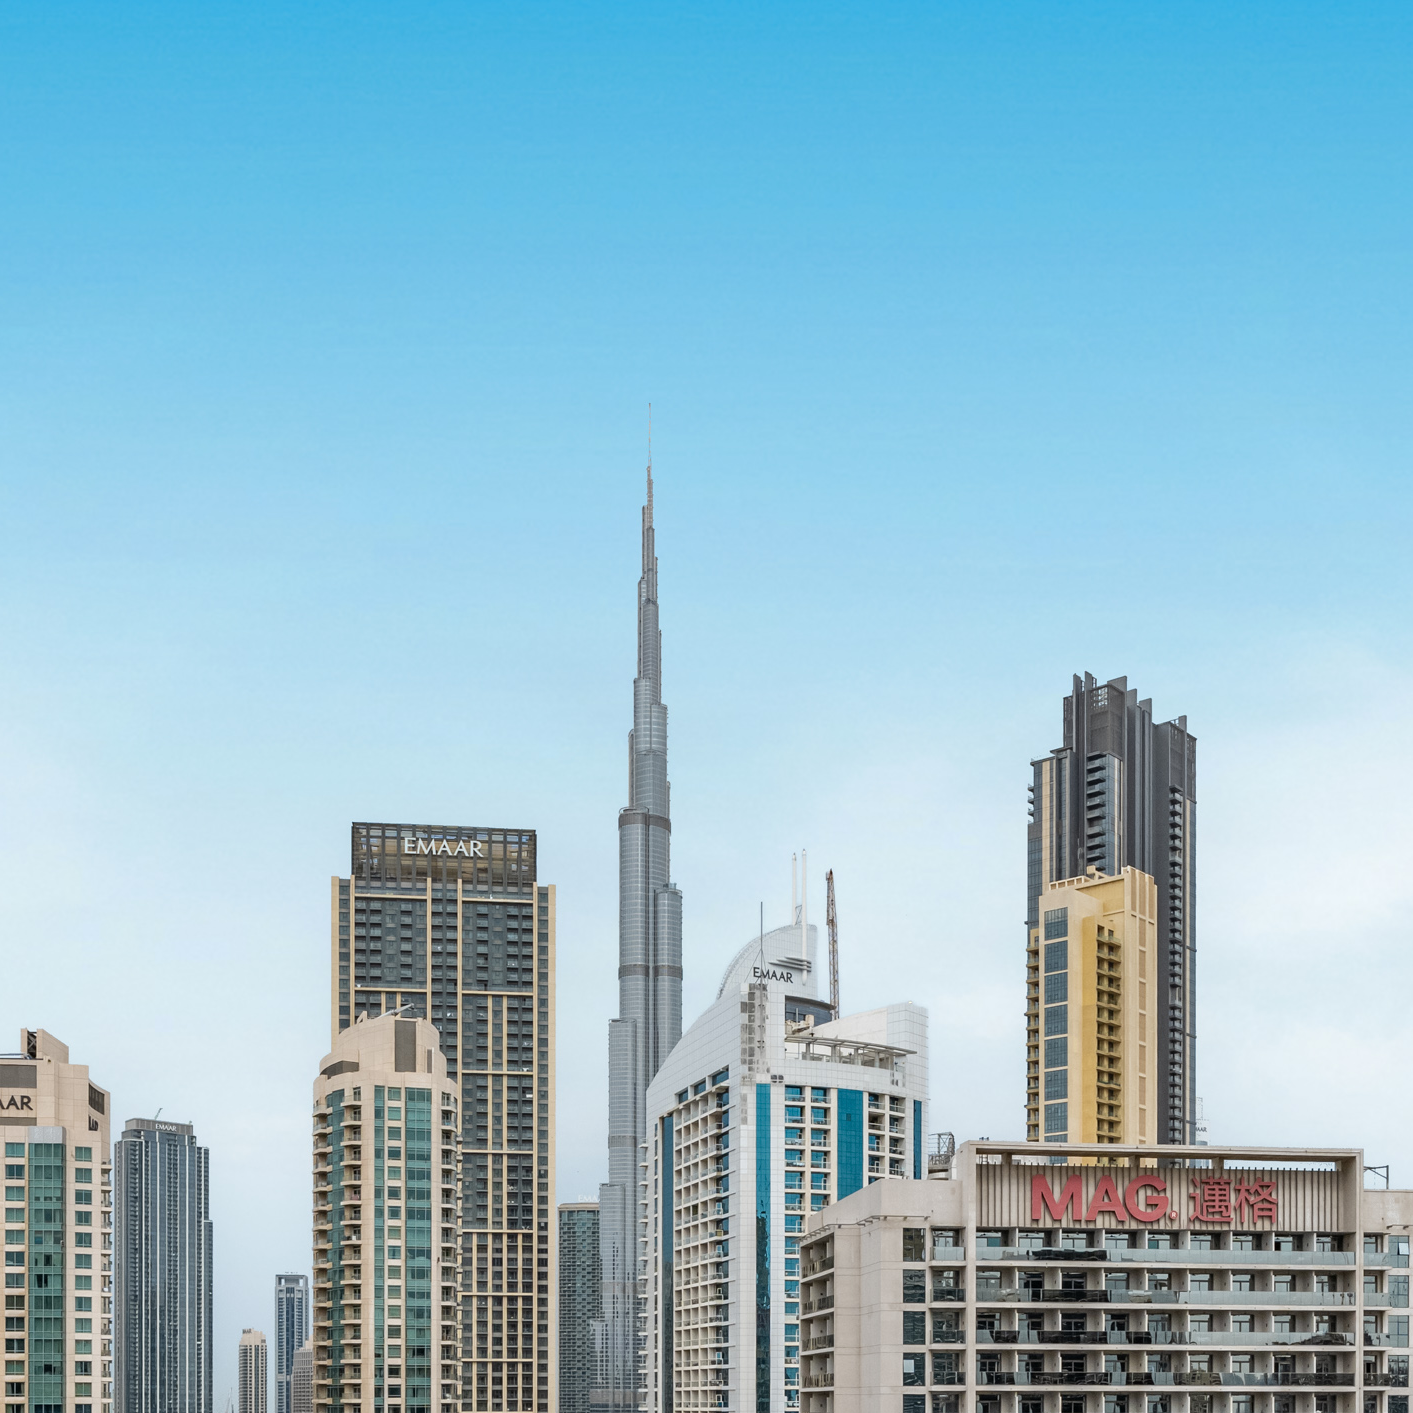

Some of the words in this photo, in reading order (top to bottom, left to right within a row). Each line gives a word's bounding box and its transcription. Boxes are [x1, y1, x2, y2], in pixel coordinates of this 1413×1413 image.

[403, 837, 484, 858] EMAAR
[753, 966, 794, 984] EMAAR
[155, 1123, 177, 1132] EMAAR
[1189, 1176, 1278, 1224] 邁格
